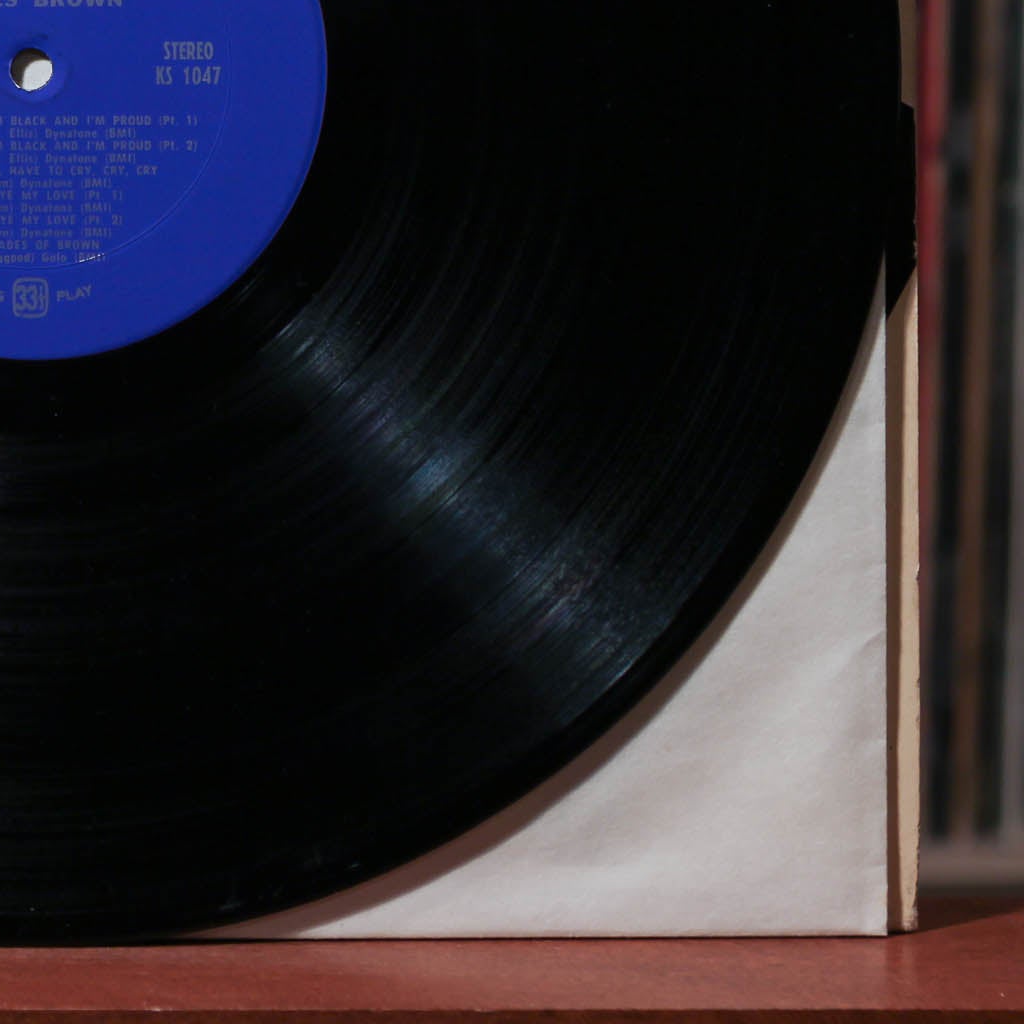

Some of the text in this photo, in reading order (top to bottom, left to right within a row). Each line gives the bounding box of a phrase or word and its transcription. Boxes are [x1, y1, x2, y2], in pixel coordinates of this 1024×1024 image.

[163, 41, 215, 61] STEREO
[155, 65, 222, 86] KS 1047
[10, 115, 47, 126] BLACK
[54, 115, 78, 126] AND
[86, 115, 105, 126] I'M
[112, 115, 152, 126] PROUD
[10, 140, 47, 151] BLACK
[54, 140, 78, 151] AND
[86, 140, 105, 151] I'M
[112, 140, 152, 151] PROUD
[9, 165, 41, 176] HAVE
[49, 165, 63, 176] TO
[136, 165, 159, 176] CRY
[21, 190, 38, 201] MY
[47, 190, 75, 201] LOVE
[22, 215, 39, 225] MY
[47, 215, 75, 225] LOVE
[35, 240, 49, 250] OF
[57, 240, 100, 250] BROWN
[56, 284, 93, 302] PLAY
